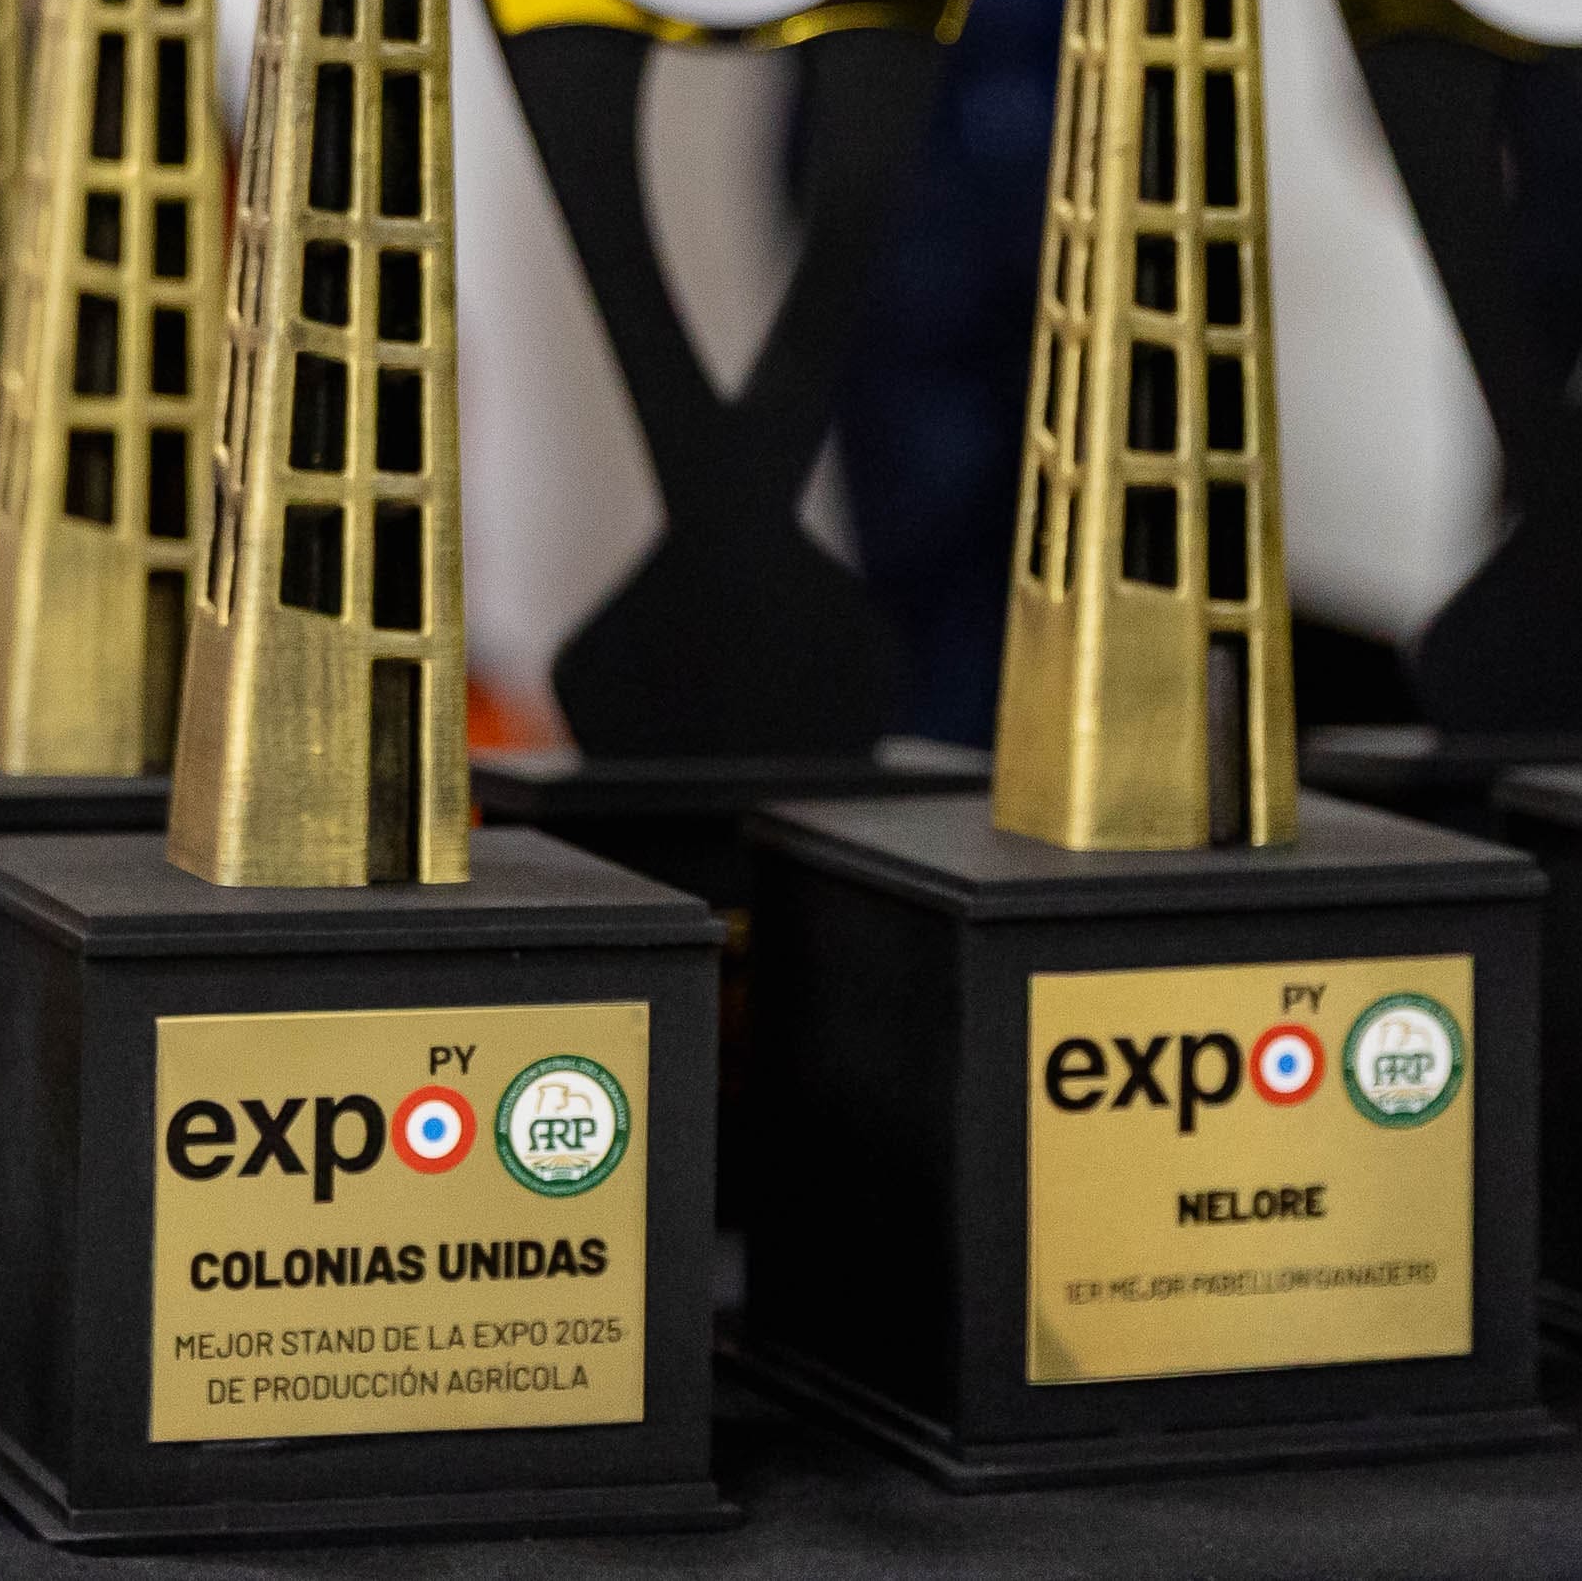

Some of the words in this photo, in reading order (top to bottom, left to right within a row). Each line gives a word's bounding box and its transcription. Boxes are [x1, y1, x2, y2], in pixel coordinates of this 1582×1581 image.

[1282, 984, 1326, 1013] PY
[429, 1044, 477, 1076] PY
[1177, 1184, 1325, 1226] NELORE
[190, 1243, 425, 1292] COLONIAS
[438, 1237, 608, 1284] UNIDAS
[175, 1331, 274, 1361] MEJOR
[280, 1328, 376, 1357] STAND
[383, 1325, 420, 1352] DE
[428, 1323, 466, 1350] LA
[473, 1320, 548, 1348] EXPO
[556, 1318, 623, 1346] 2025
[207, 1377, 246, 1405] DE
[253, 1364, 439, 1403] PRODUCCIÓN
[446, 1361, 590, 1394] AGRÍCOLA
